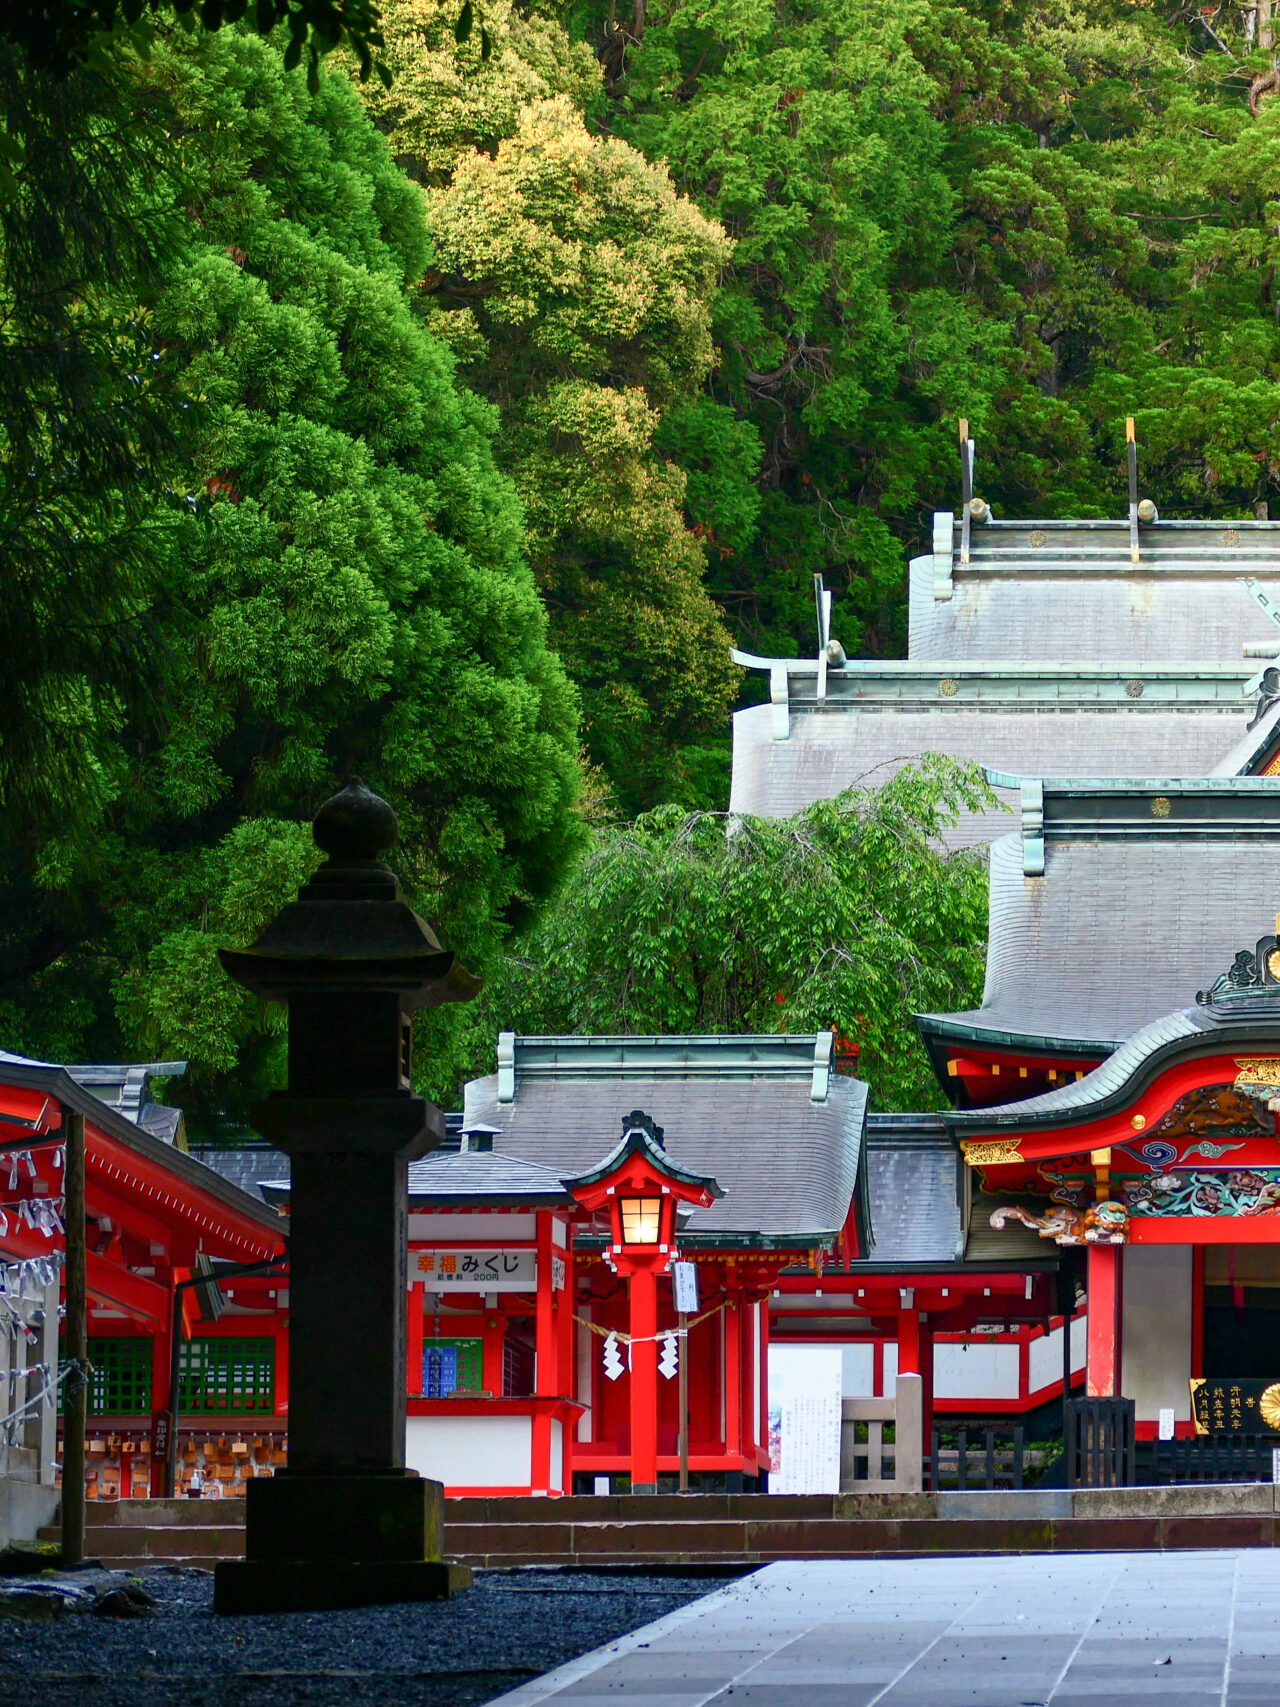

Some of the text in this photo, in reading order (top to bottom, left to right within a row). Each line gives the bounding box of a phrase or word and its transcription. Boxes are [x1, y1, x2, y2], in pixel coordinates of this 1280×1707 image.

[417, 1254, 519, 1273] 幸福みくじ
[473, 1273, 499, 1281] 200円
